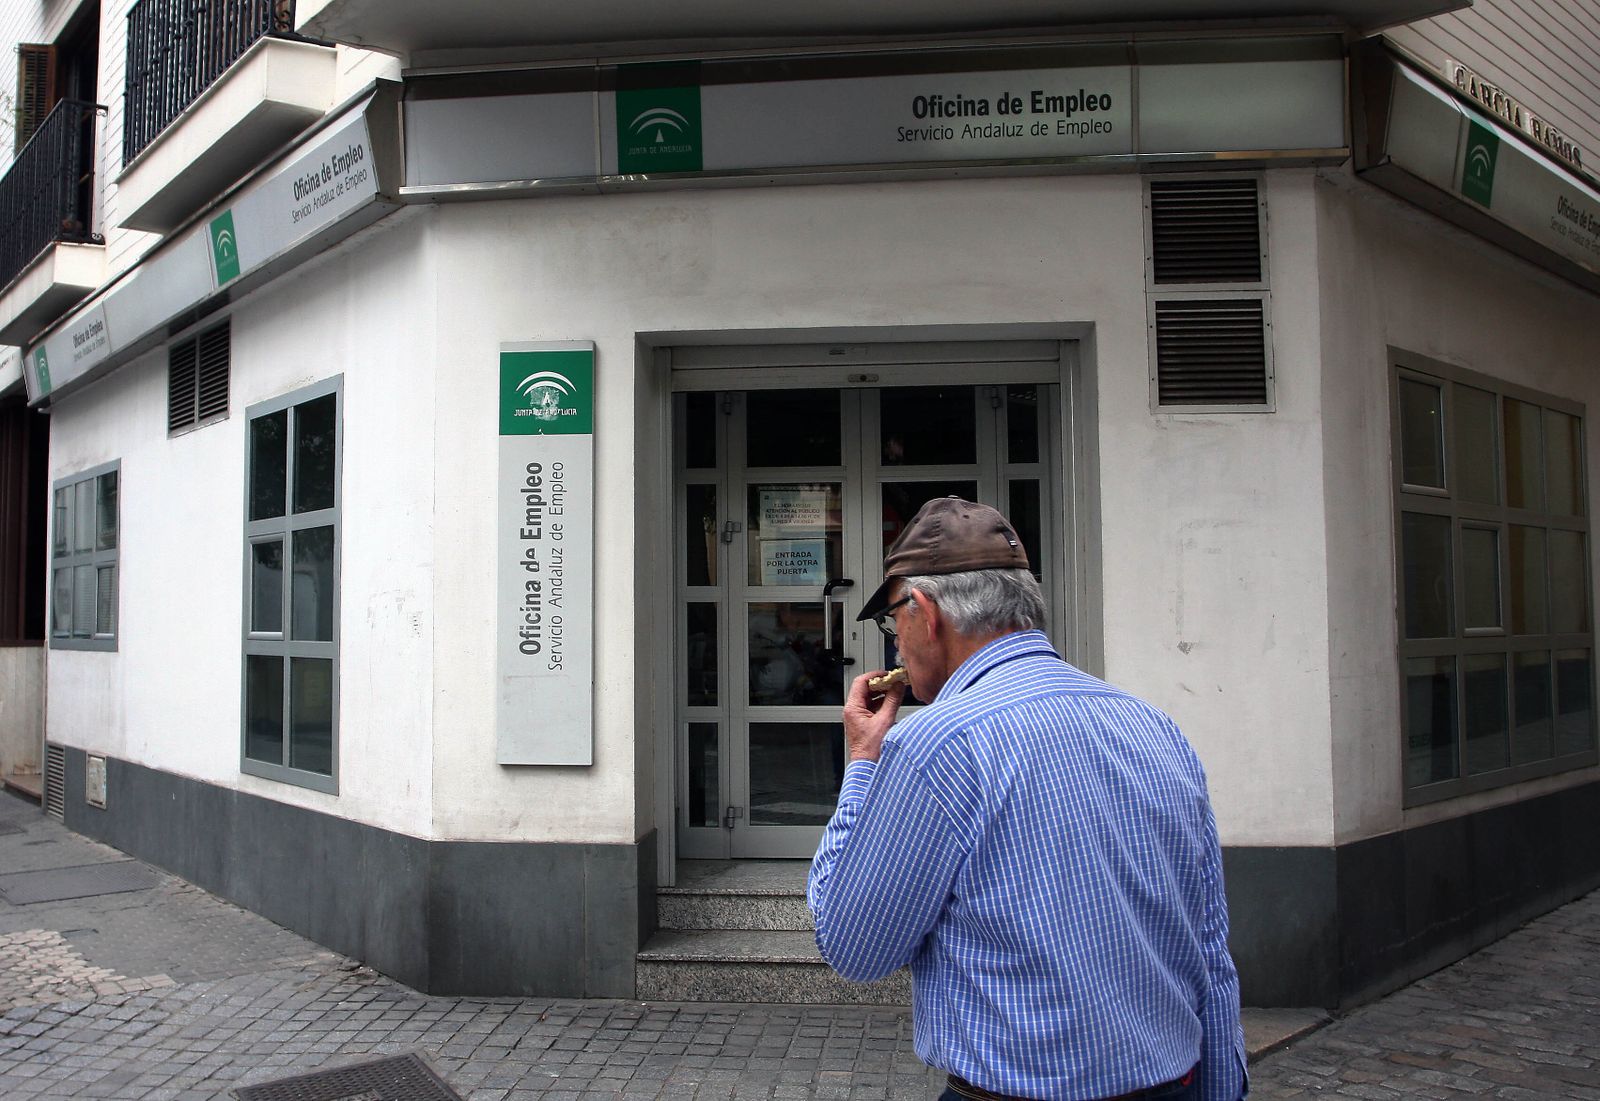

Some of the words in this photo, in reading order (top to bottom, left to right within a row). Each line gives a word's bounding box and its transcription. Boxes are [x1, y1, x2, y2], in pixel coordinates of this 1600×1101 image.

[897, 126, 954, 142] Servicio
[961, 123, 1024, 139] Andaluz
[1030, 121, 1049, 136] de
[1056, 119, 1113, 138] Empleo
[912, 94, 990, 119] Oficina
[997, 92, 1023, 115] de
[1031, 89, 1112, 117] Empleo
[292, 202, 312, 224] Servicio
[313, 188, 335, 212] Andaluz
[336, 182, 344, 197] de
[344, 168, 368, 191] Empleo
[293, 172, 321, 202] Oficina
[321, 162, 332, 185] de
[331, 144, 364, 177] Empleo
[520, 462, 547, 540] Empleo
[549, 462, 567, 516] Empleo
[549, 523, 563, 541] de
[775, 551, 812, 559] ENTRADA
[519, 547, 540, 573] de
[549, 547, 563, 608] Andaluz
[797, 559, 819, 567] OTRA
[519, 580, 542, 655] Oficina
[548, 615, 563, 671] Servicio
